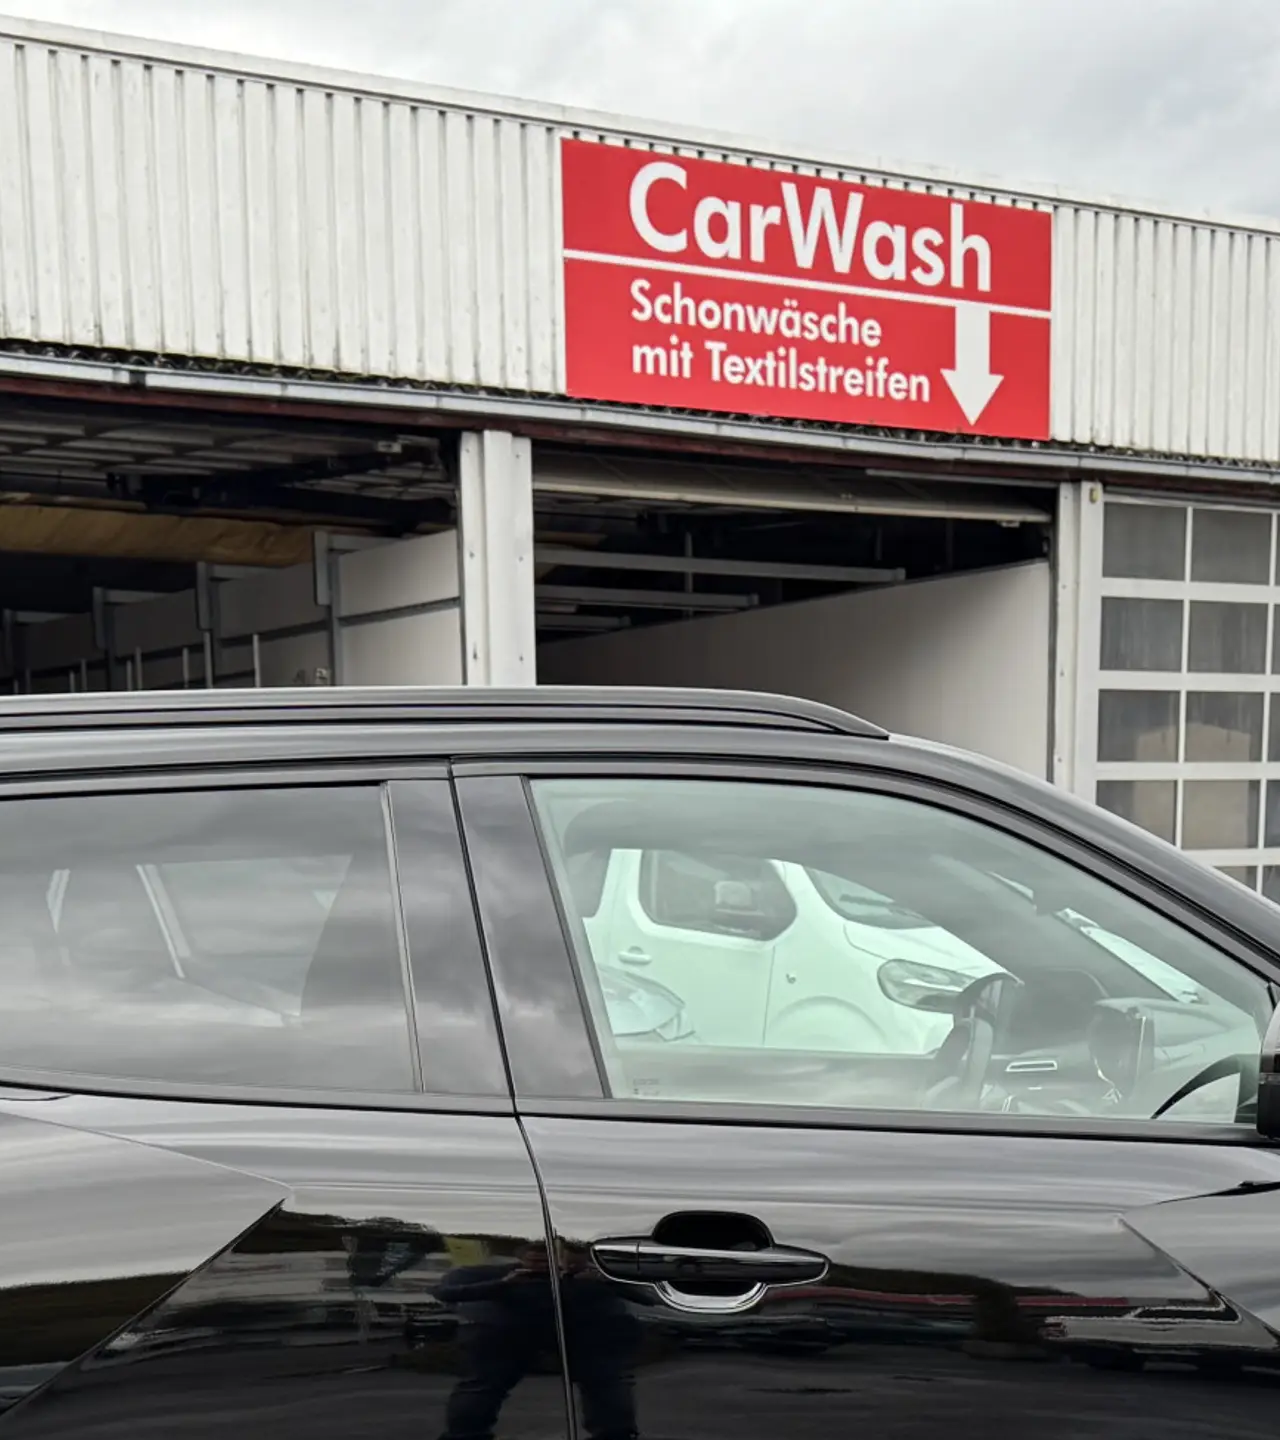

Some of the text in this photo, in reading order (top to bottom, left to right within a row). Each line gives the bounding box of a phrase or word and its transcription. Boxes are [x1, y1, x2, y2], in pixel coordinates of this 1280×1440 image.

[628, 160, 992, 293] CarWash
[630, 278, 883, 347] Schonwäsche
[631, 335, 930, 403] mit Textilstreifen
